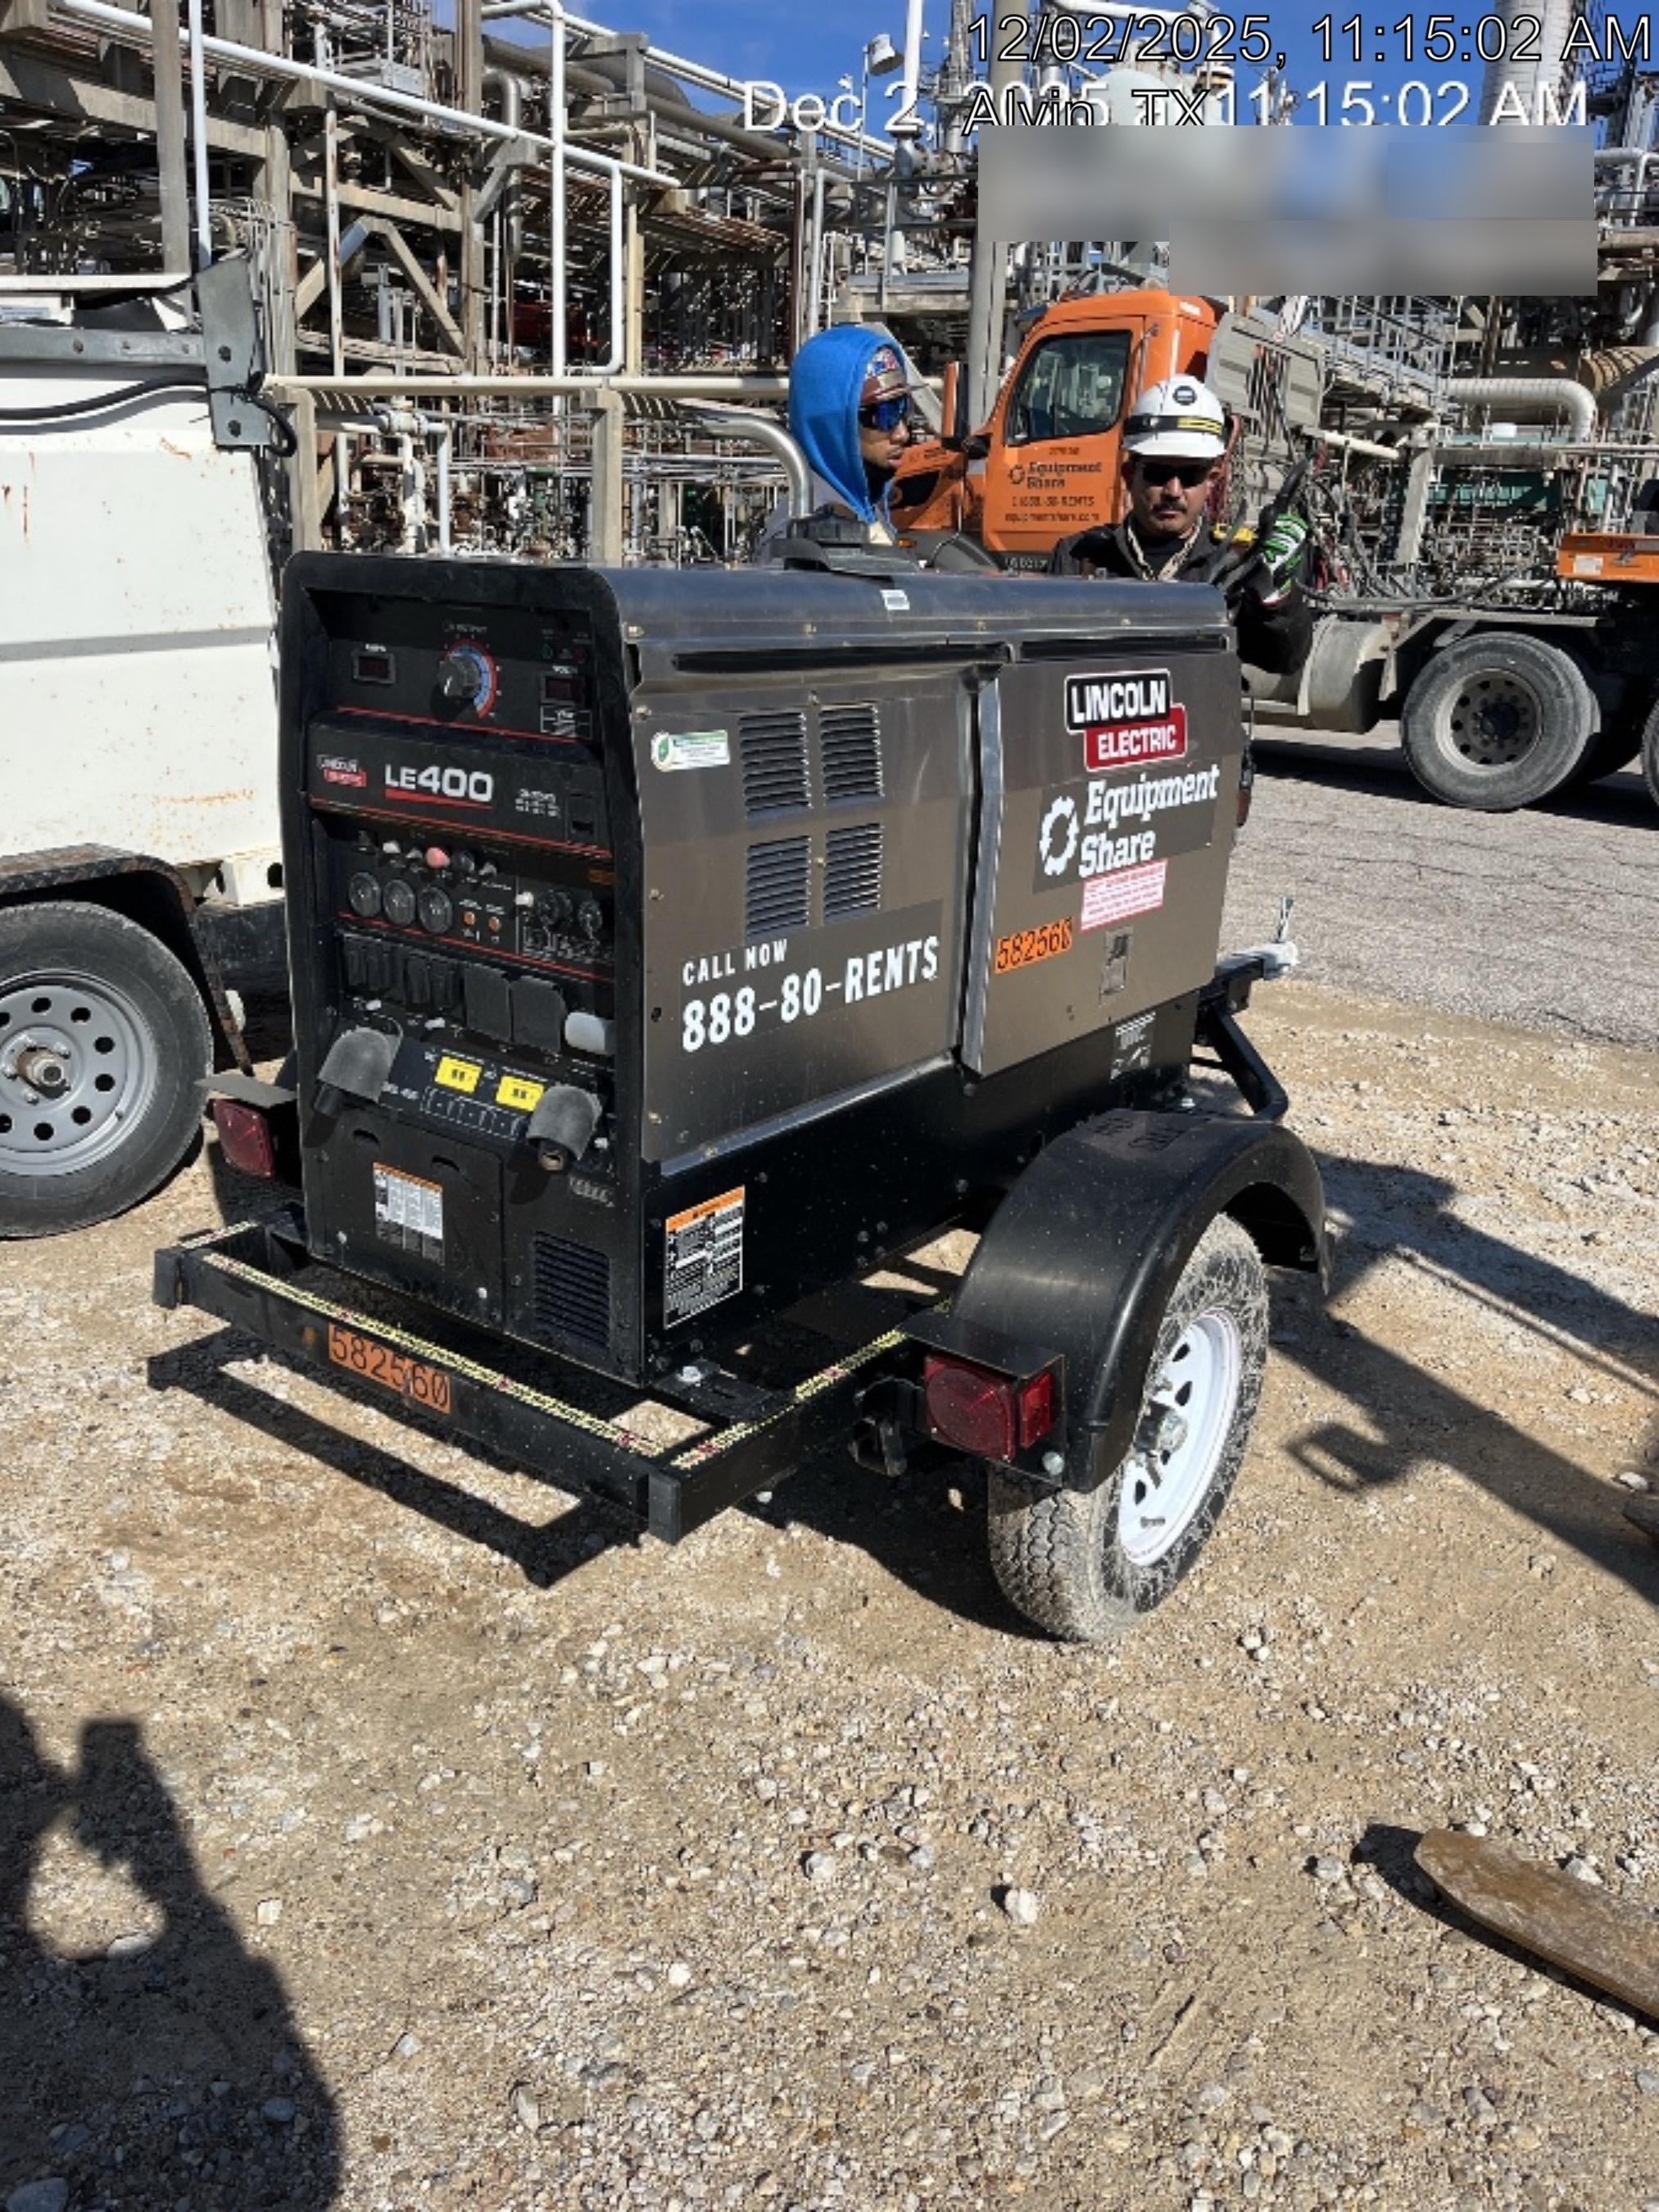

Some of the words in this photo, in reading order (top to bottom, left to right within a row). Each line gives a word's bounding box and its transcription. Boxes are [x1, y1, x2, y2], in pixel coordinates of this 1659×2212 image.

[1071, 680, 1167, 723] LINCOLN
[1097, 724, 1176, 760] ELECTRIC
[385, 764, 494, 802] LE400
[1083, 764, 1221, 829] Equipment
[1078, 829, 1156, 878] Share
[682, 953, 736, 986] CALL
[745, 938, 787, 972] NOW
[997, 916, 1072, 968] 582560
[682, 936, 940, 1053] 888-80-RENTS
[332, 1326, 447, 1407] 582560
